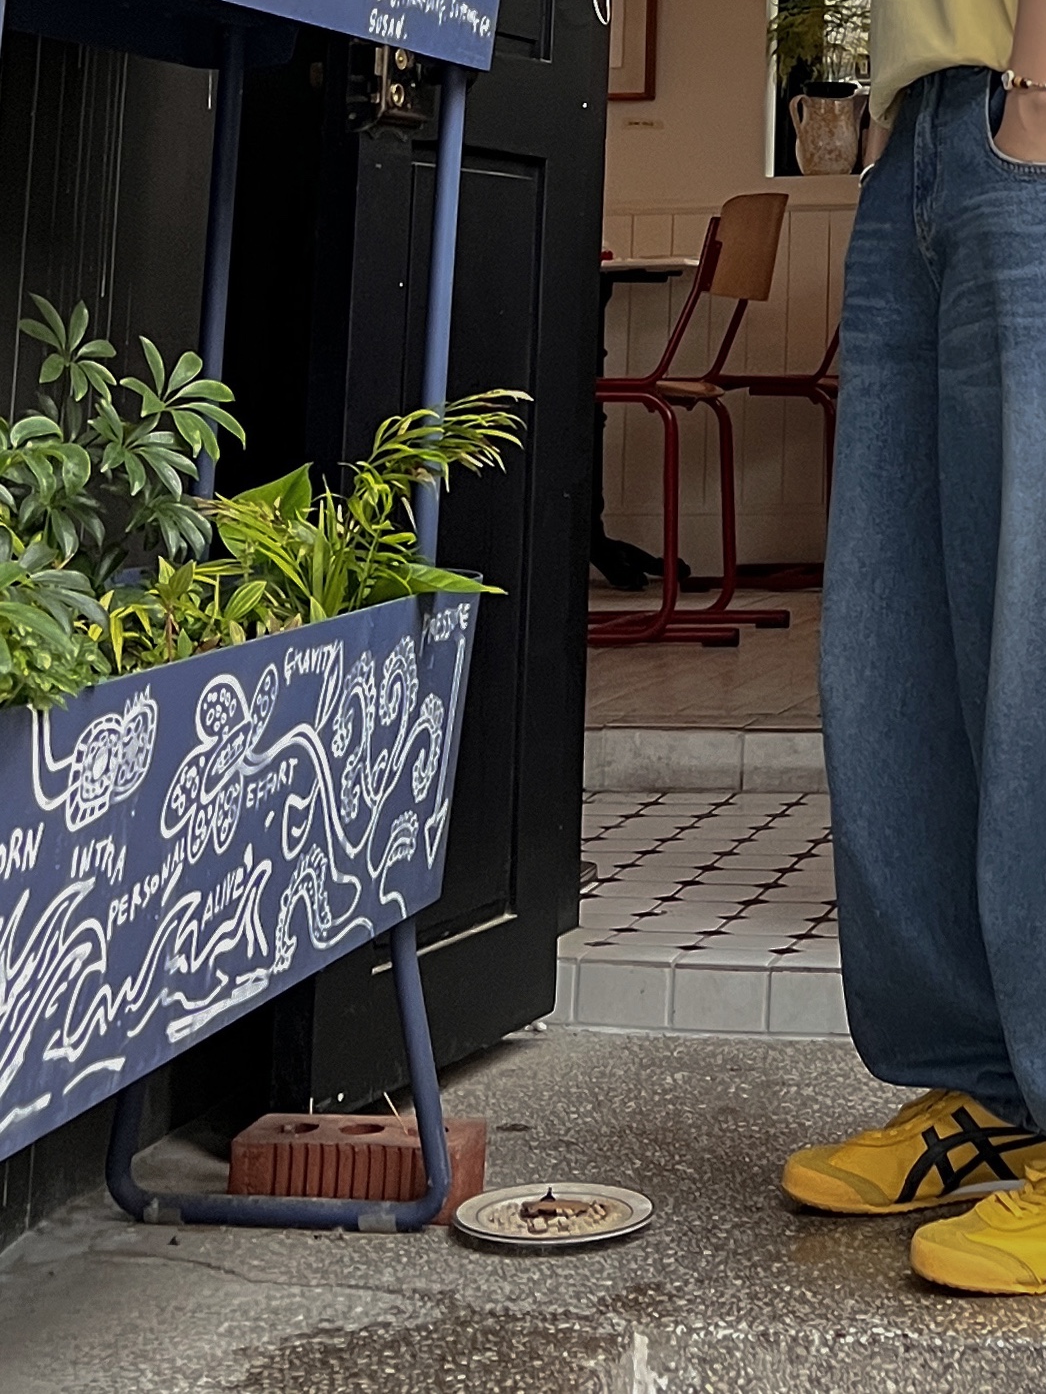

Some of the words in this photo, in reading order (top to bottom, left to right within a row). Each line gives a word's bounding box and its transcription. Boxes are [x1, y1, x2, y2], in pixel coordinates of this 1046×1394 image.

[283, 640, 342, 686] GRAVITY
[71, 834, 127, 886] INTRA
[107, 837, 186, 941] PERSONAL
